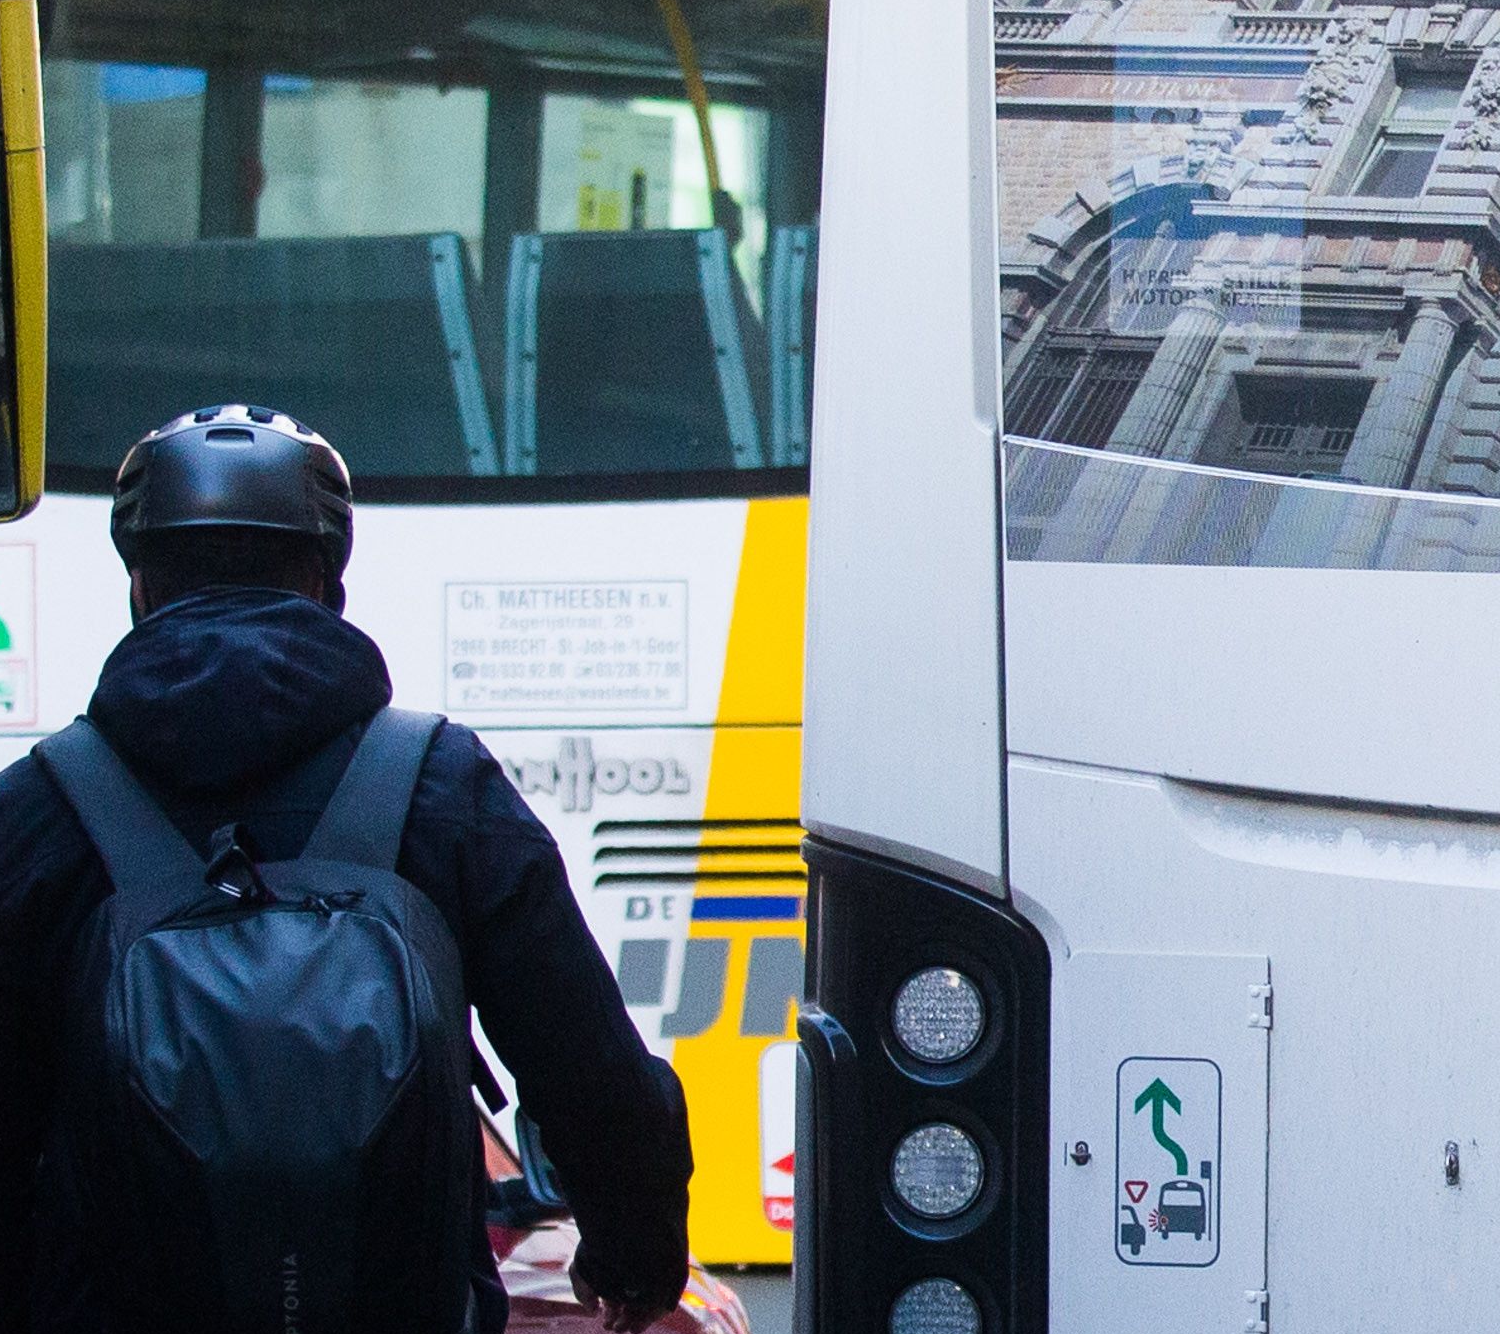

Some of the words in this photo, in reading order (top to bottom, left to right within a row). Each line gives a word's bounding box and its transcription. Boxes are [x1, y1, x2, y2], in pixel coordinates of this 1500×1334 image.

[460, 589, 491, 611] Ch.
[498, 588, 632, 610] MATTHEESEN
[625, 895, 674, 921] DE
